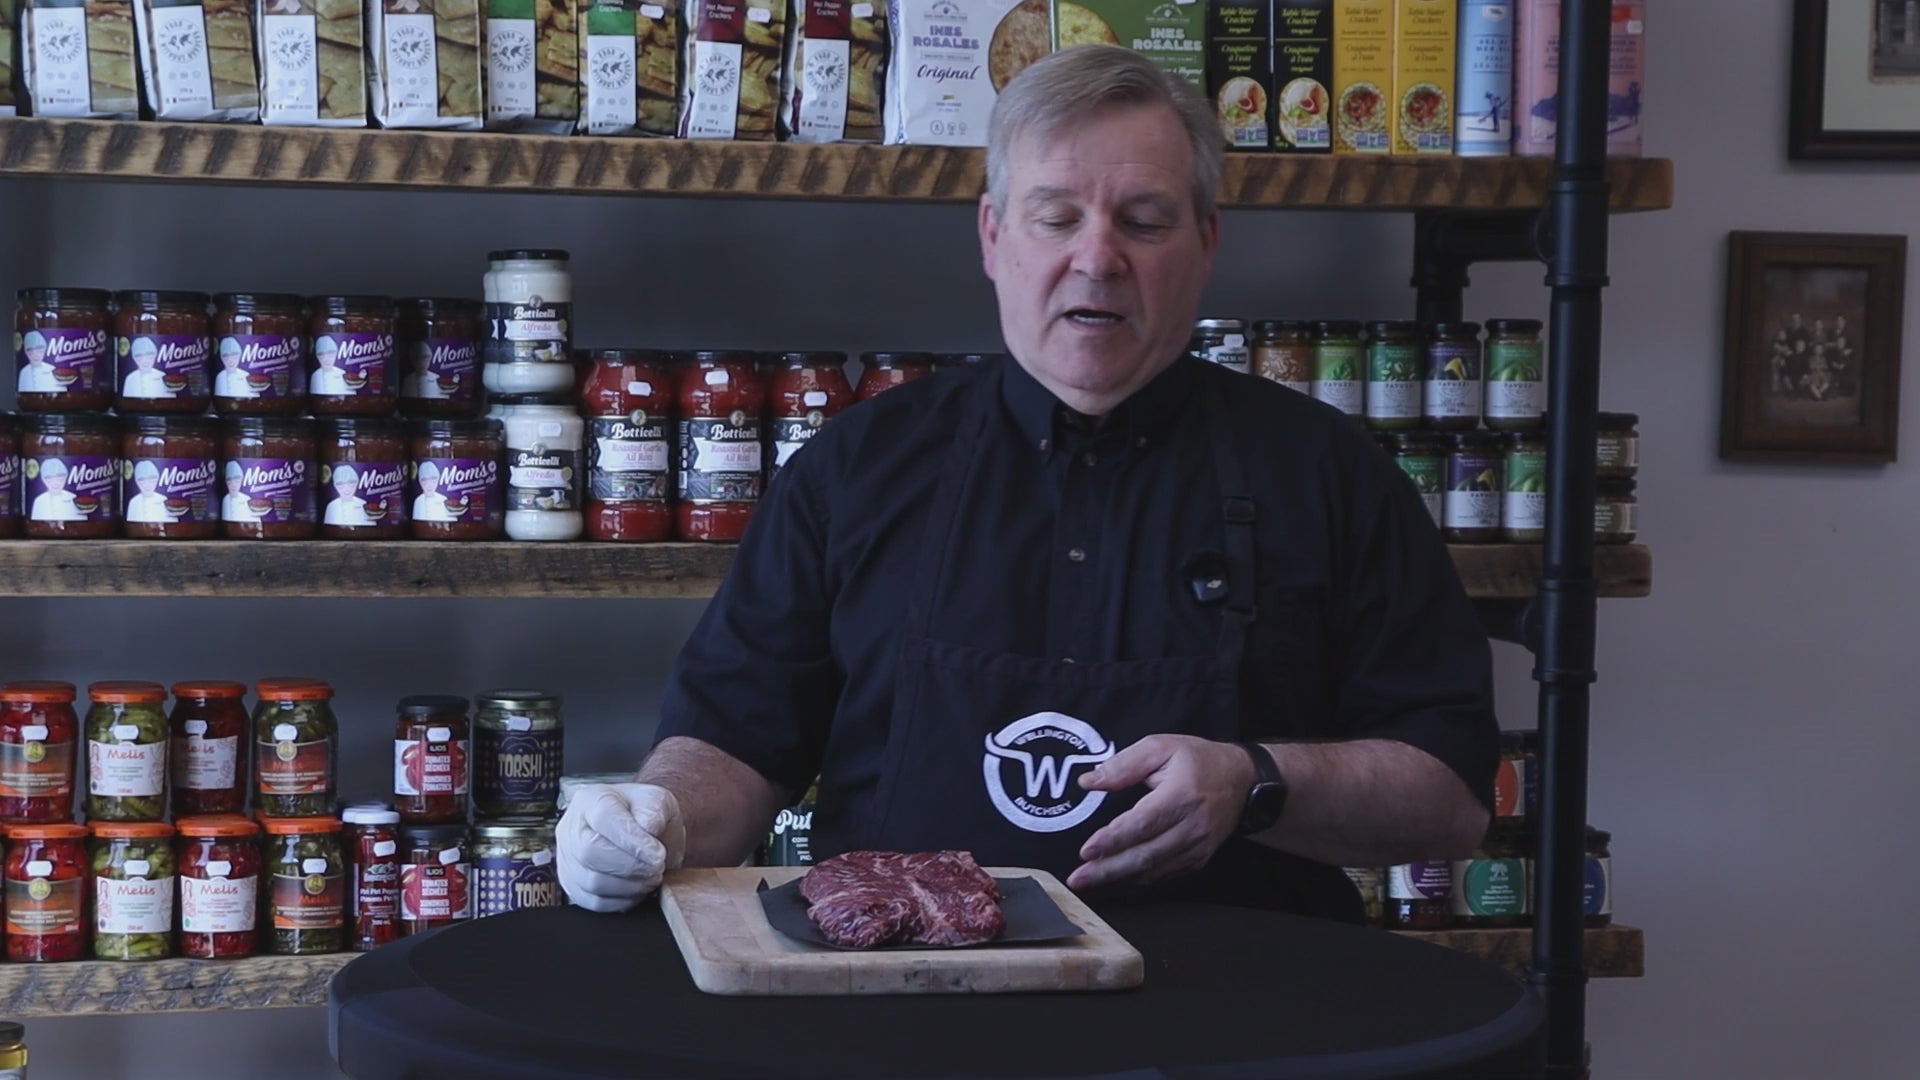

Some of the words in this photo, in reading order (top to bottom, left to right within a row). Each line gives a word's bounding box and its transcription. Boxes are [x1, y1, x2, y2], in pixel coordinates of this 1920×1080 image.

[1224, 16, 1254, 24] Crackers
[930, 25, 962, 37] INES
[1150, 28, 1185, 40] INES
[913, 36, 980, 50] ROSALES
[1132, 38, 1202, 51] ROSALES
[916, 64, 982, 83] Original
[46, 331, 97, 357] Mom's
[157, 338, 204, 364] Mom's
[240, 336, 291, 363] Mom's
[338, 334, 386, 360] Mom's
[432, 340, 476, 364] Mom's
[611, 422, 662, 440] Botticelli
[710, 423, 758, 441] Botticelli
[518, 452, 560, 467] Botticelli
[68, 458, 115, 485] Mom's
[159, 458, 208, 487] Mom's
[244, 462, 294, 488] Mom's
[358, 464, 402, 490] Mom's
[439, 461, 488, 487] Mom's
[1014, 729, 1086, 750] WELLINGTON
[107, 750, 145, 760] Melis
[499, 753, 542, 778] TORSHI
[1014, 797, 1072, 816] BUTCHERY
[118, 885, 156, 896] Melis
[200, 884, 238, 895] Melis
